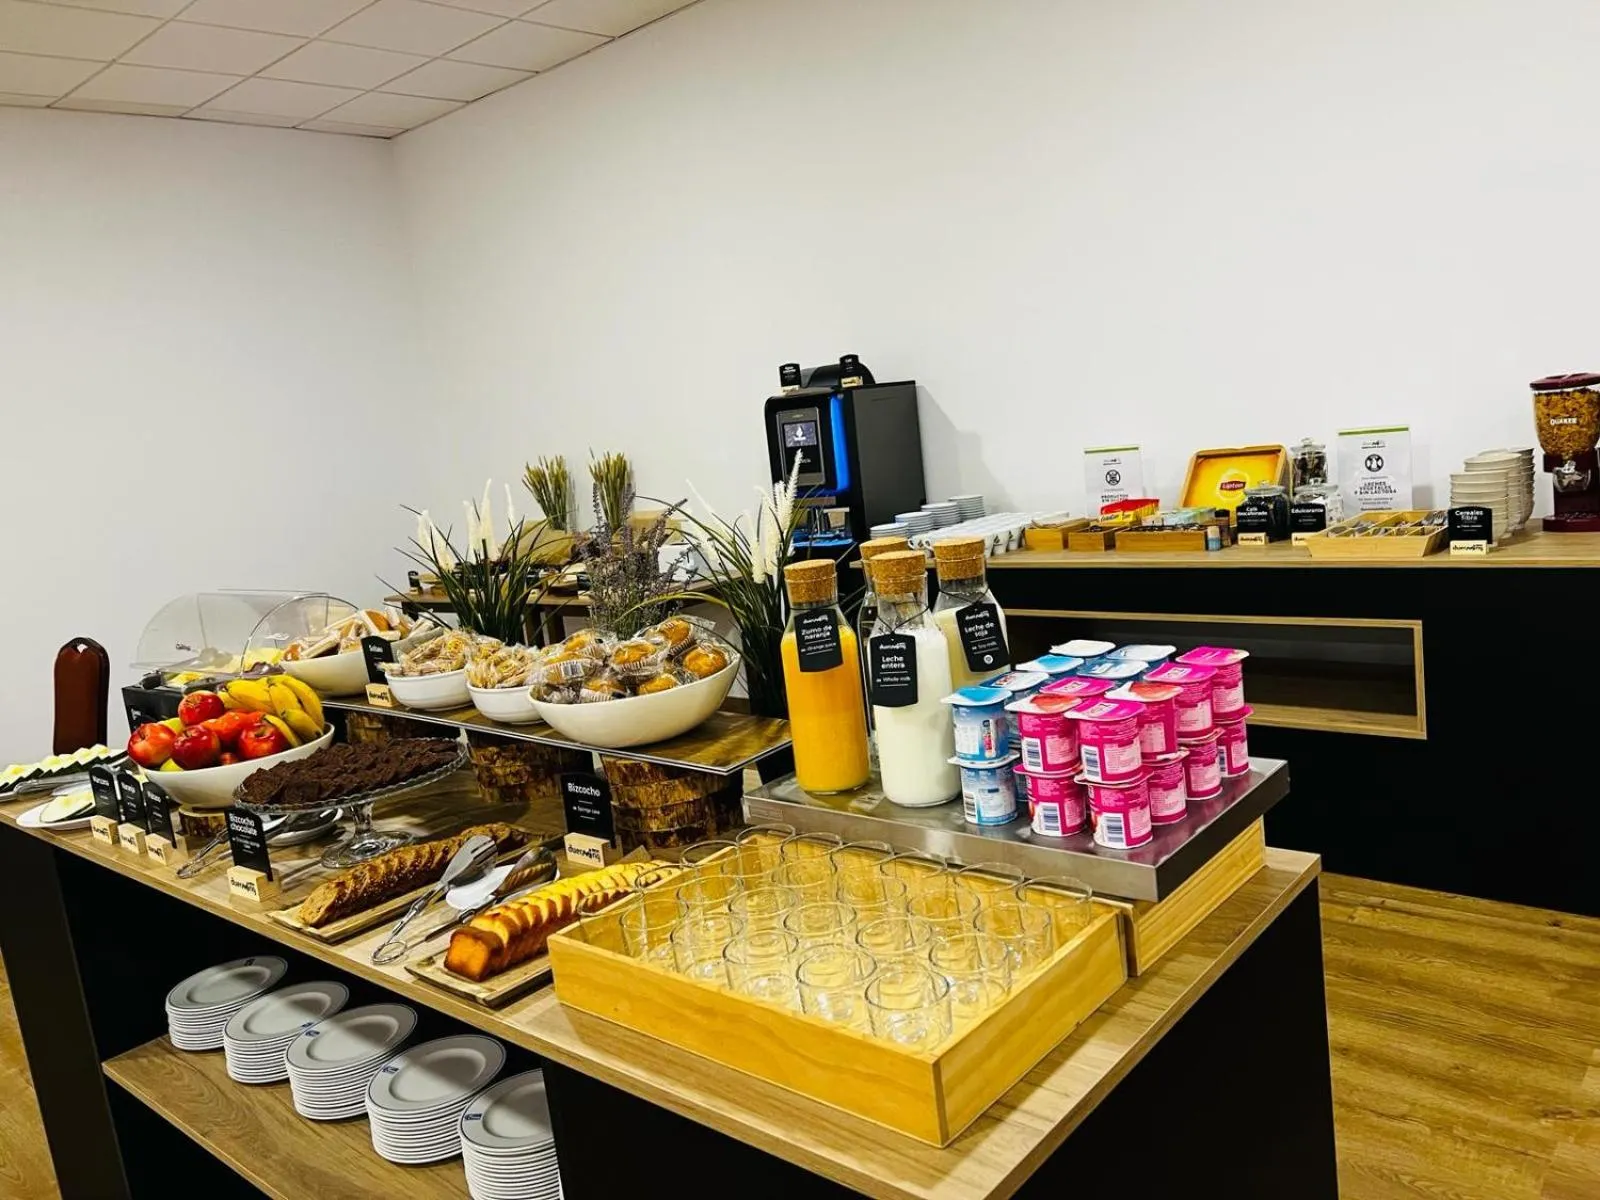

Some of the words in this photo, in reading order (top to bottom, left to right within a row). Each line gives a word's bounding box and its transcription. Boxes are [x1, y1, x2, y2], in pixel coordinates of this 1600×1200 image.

[1550, 417, 1577, 426] QUAKER
[1222, 482, 1244, 490] Lipton
[801, 627, 822, 636] Zumo
[964, 624, 984, 633] Leche
[804, 631, 831, 640] naranja
[881, 655, 904, 663] Leche
[567, 782, 601, 797] Bizcocho
[229, 813, 255, 828] Bizcocho
[230, 822, 258, 836] chocolate
